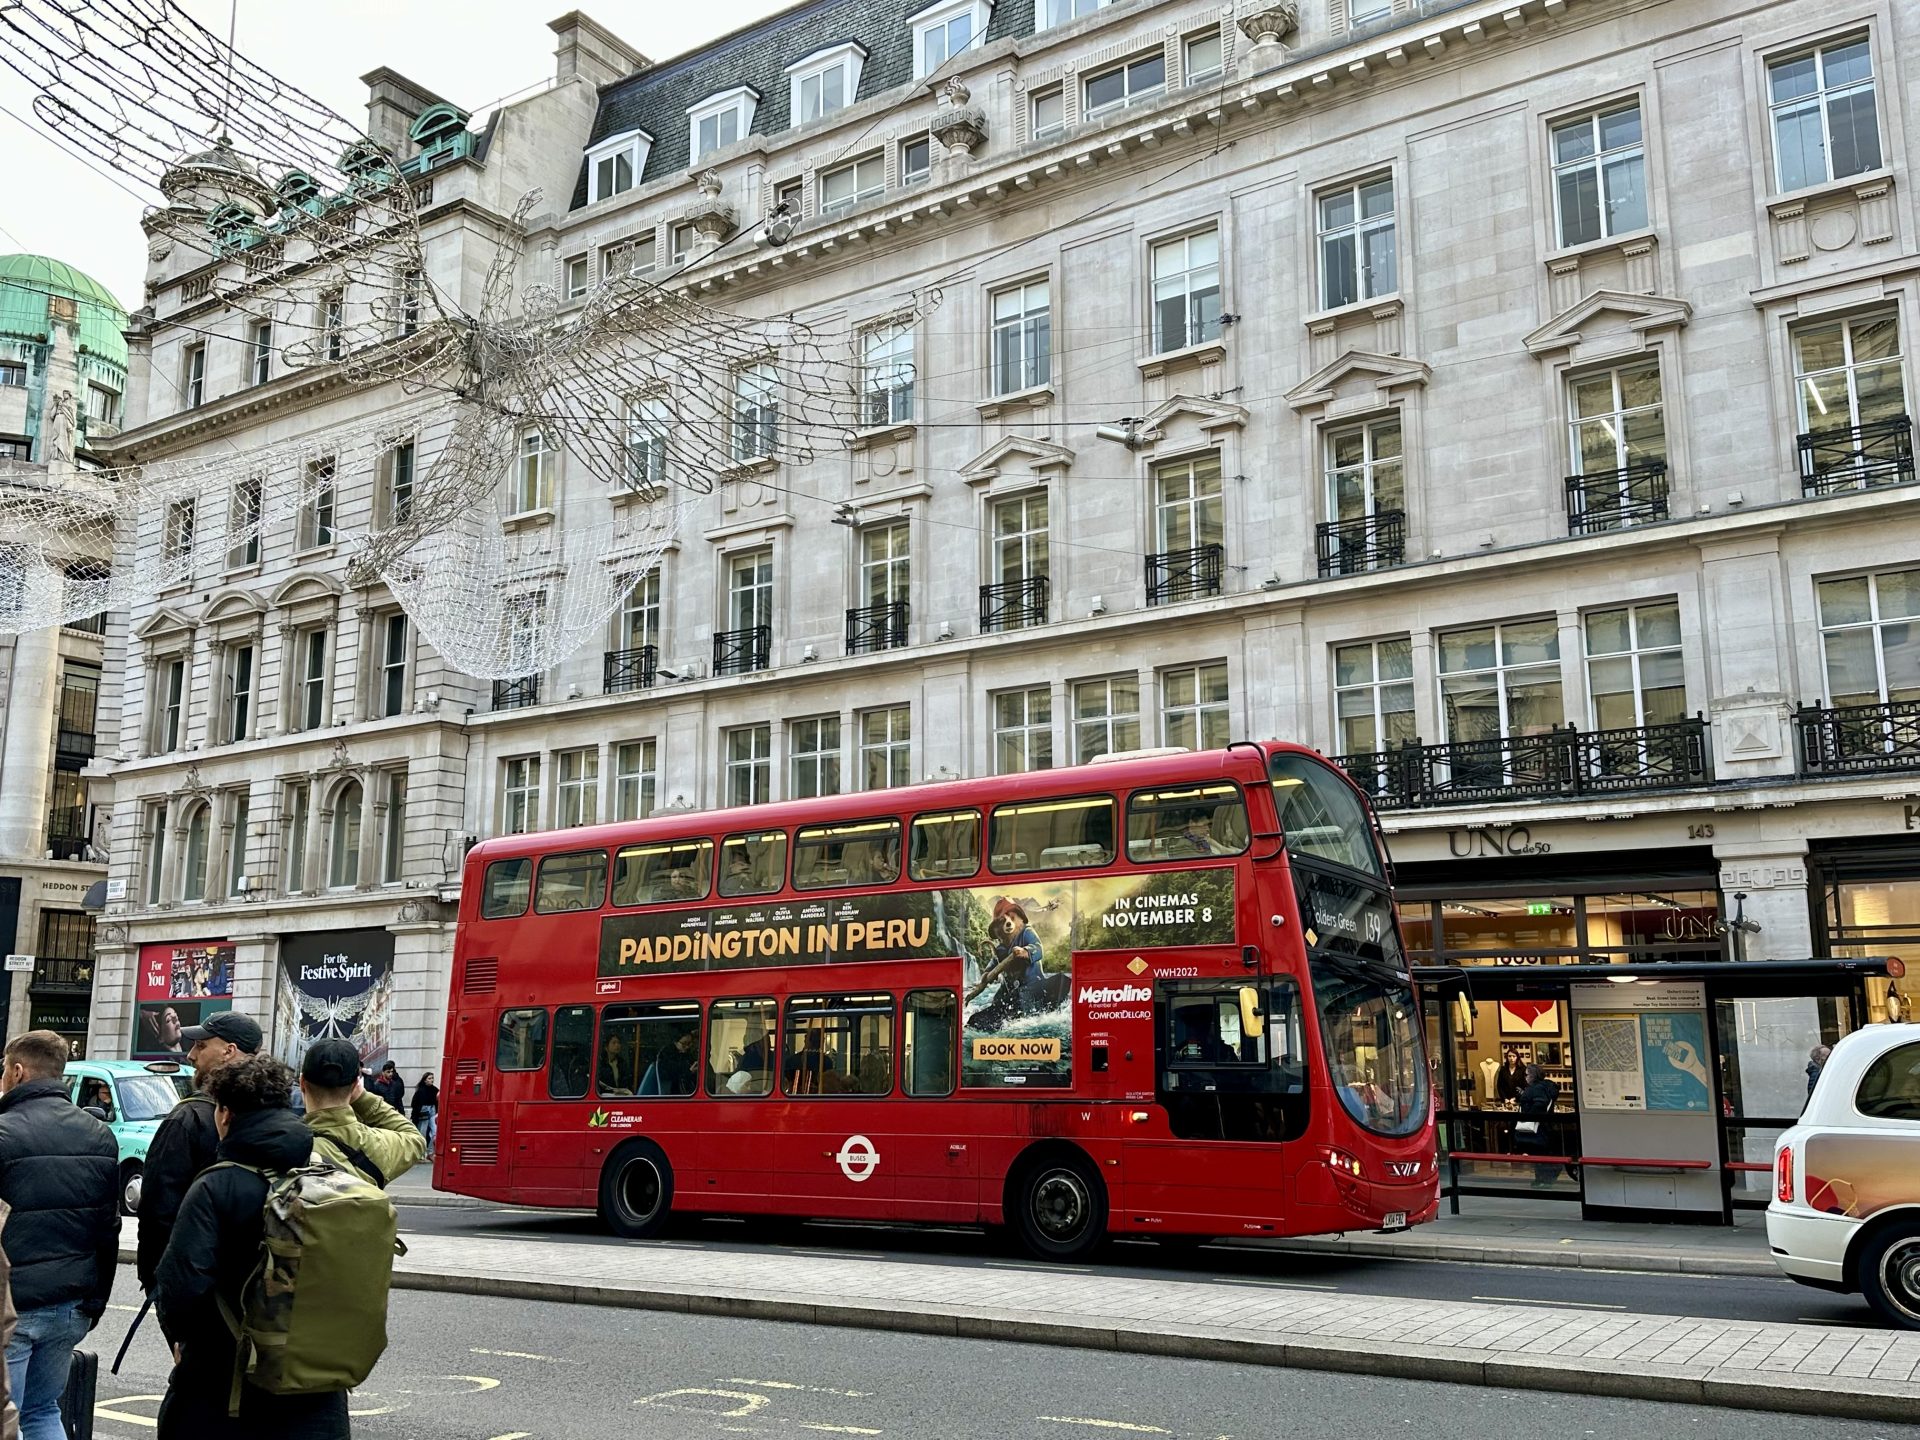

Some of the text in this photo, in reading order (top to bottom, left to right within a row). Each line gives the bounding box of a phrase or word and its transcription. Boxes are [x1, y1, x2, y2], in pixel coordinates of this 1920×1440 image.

[1688, 824, 1715, 839] 143
[42, 882, 78, 891] HEDDON
[1115, 893, 1199, 910] IN CINEMAS
[1102, 908, 1213, 928] NOVEMBER 8
[1314, 907, 1358, 933] olders Green
[1365, 911, 1381, 943] 139
[807, 923, 838, 954] IN
[846, 917, 930, 950] PERU
[151, 960, 163, 971] For
[323, 953, 349, 964] For the
[148, 972, 165, 987] You
[300, 962, 372, 982] Festive Spirit
[1153, 966, 1198, 978] VWH2022
[1078, 985, 1152, 1004] Metroline
[37, 1016, 69, 1024] ARMANI
[980, 1043, 1053, 1056] BOOK NOW
[1081, 1112, 1091, 1121] W
